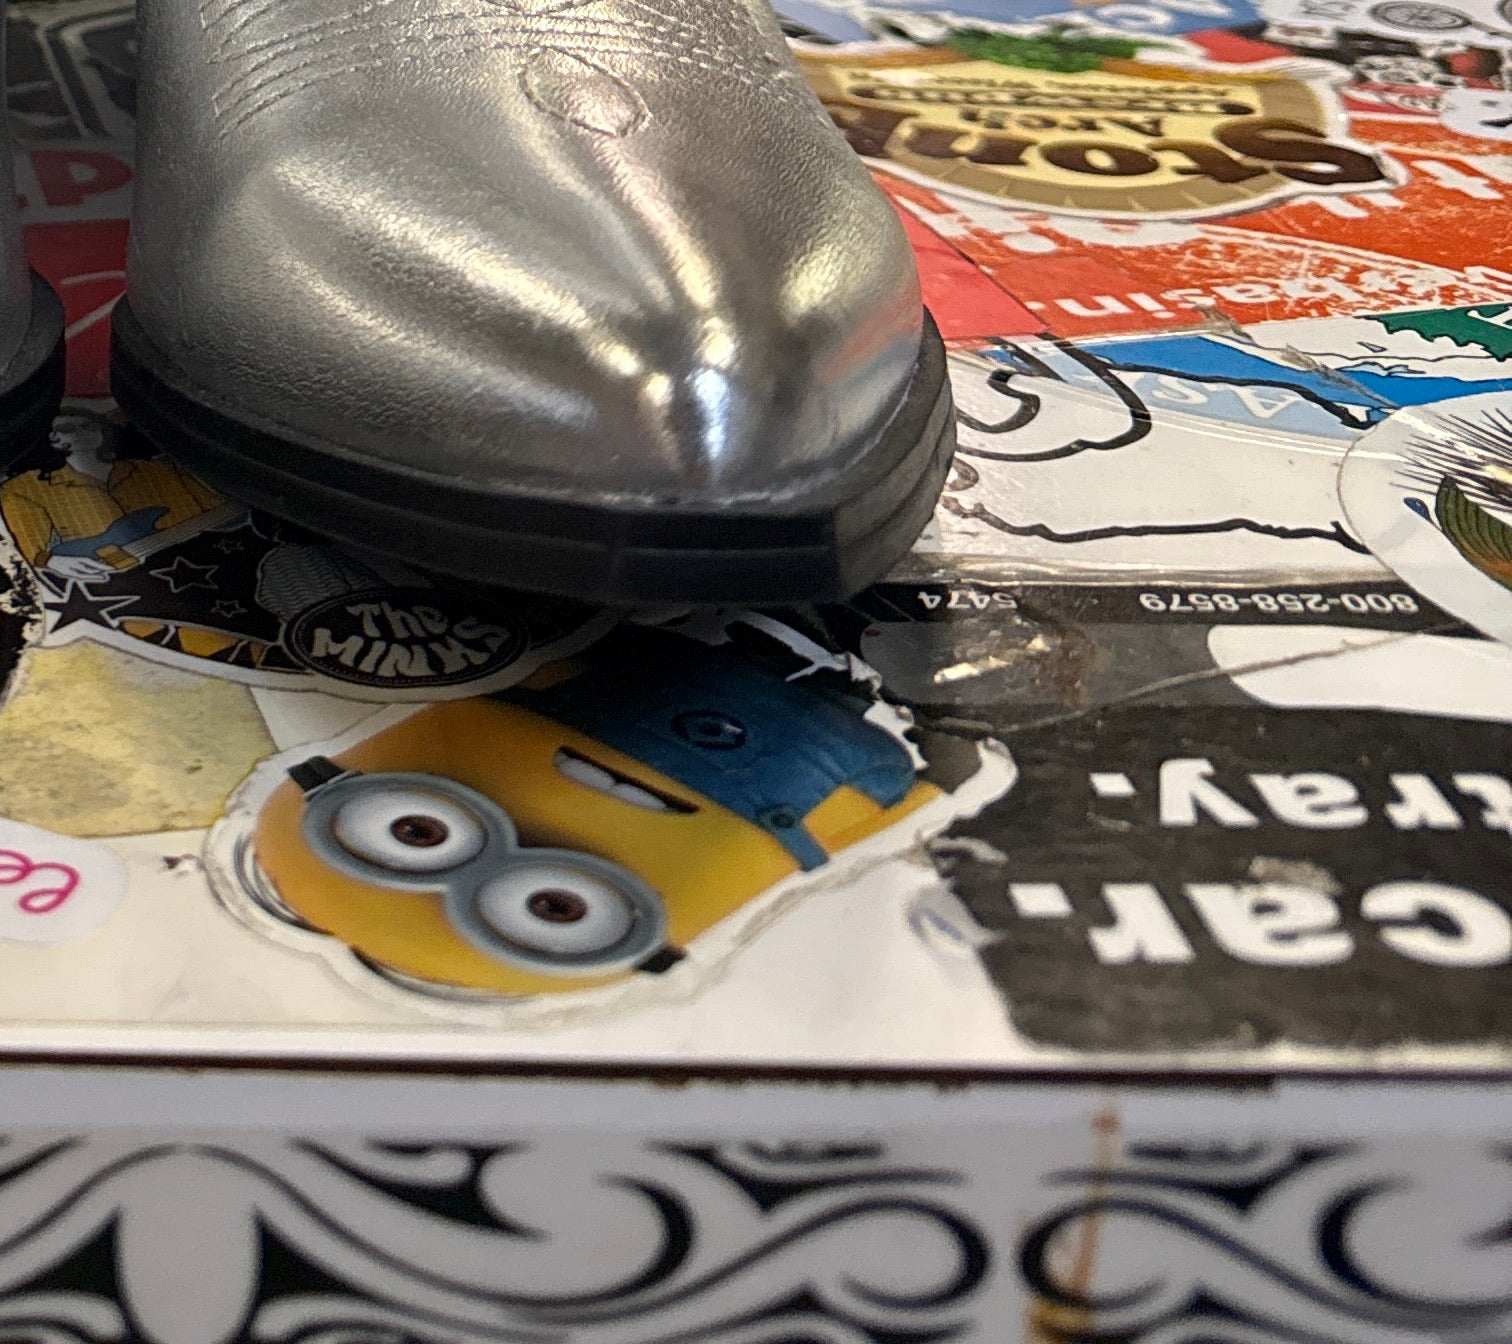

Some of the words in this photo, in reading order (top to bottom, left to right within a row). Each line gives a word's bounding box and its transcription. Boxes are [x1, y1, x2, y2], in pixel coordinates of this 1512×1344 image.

[346, 601, 449, 639] The
[918, 590, 1018, 612] 5474
[1138, 591, 1420, 614] 800-258-8579
[309, 615, 511, 677] MINKS
[1007, 878, 1512, 968] car.
